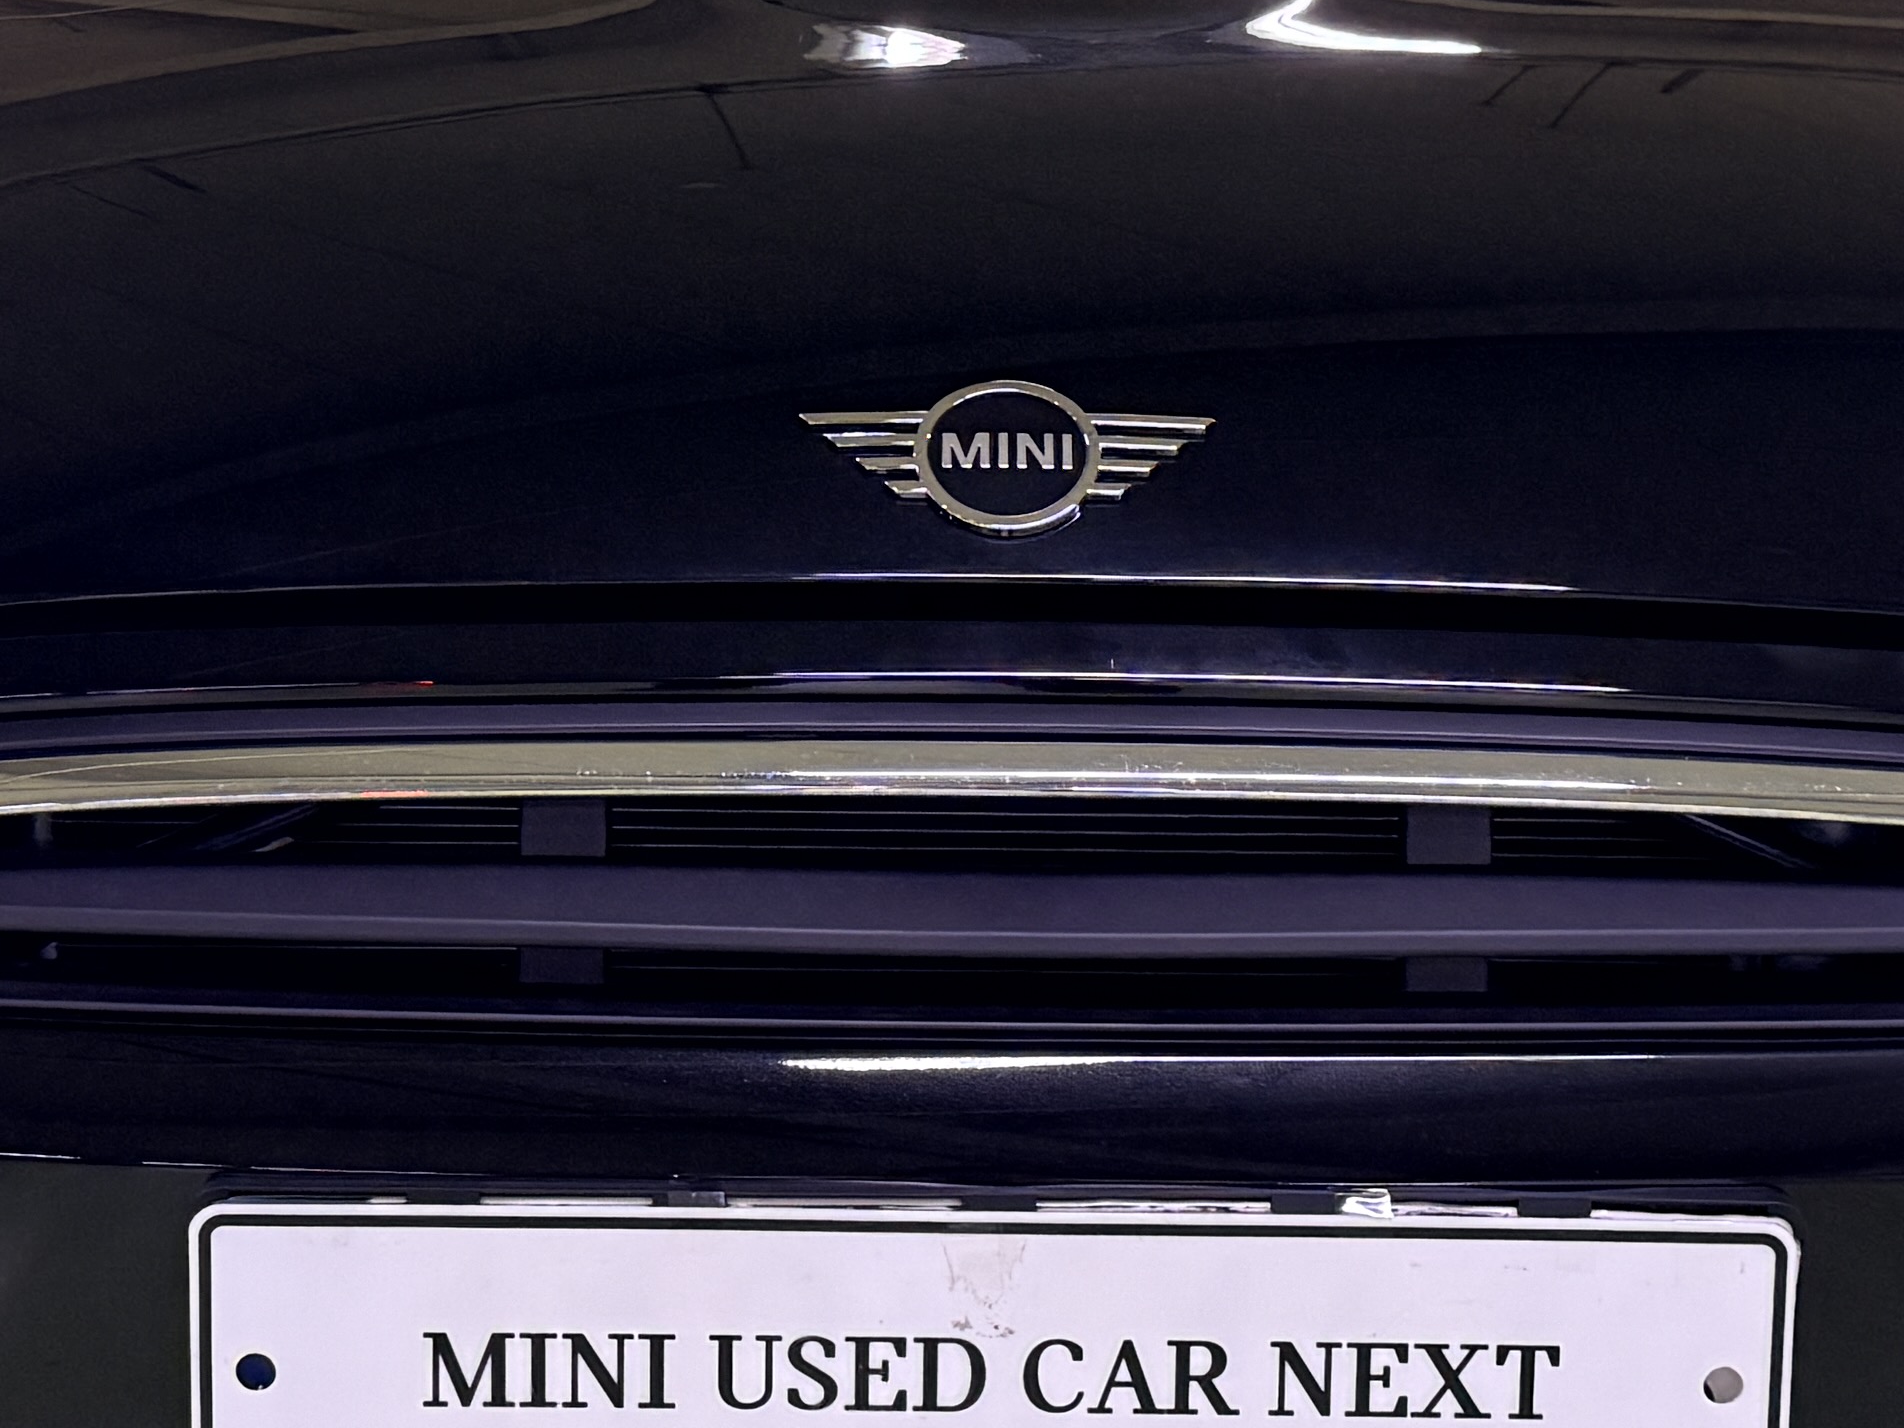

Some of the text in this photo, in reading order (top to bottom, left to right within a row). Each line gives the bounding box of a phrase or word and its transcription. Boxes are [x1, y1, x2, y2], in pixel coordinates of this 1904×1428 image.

[941, 431, 1074, 470] MINI
[422, 1332, 1561, 1420] MINI USED CAR NEXT
